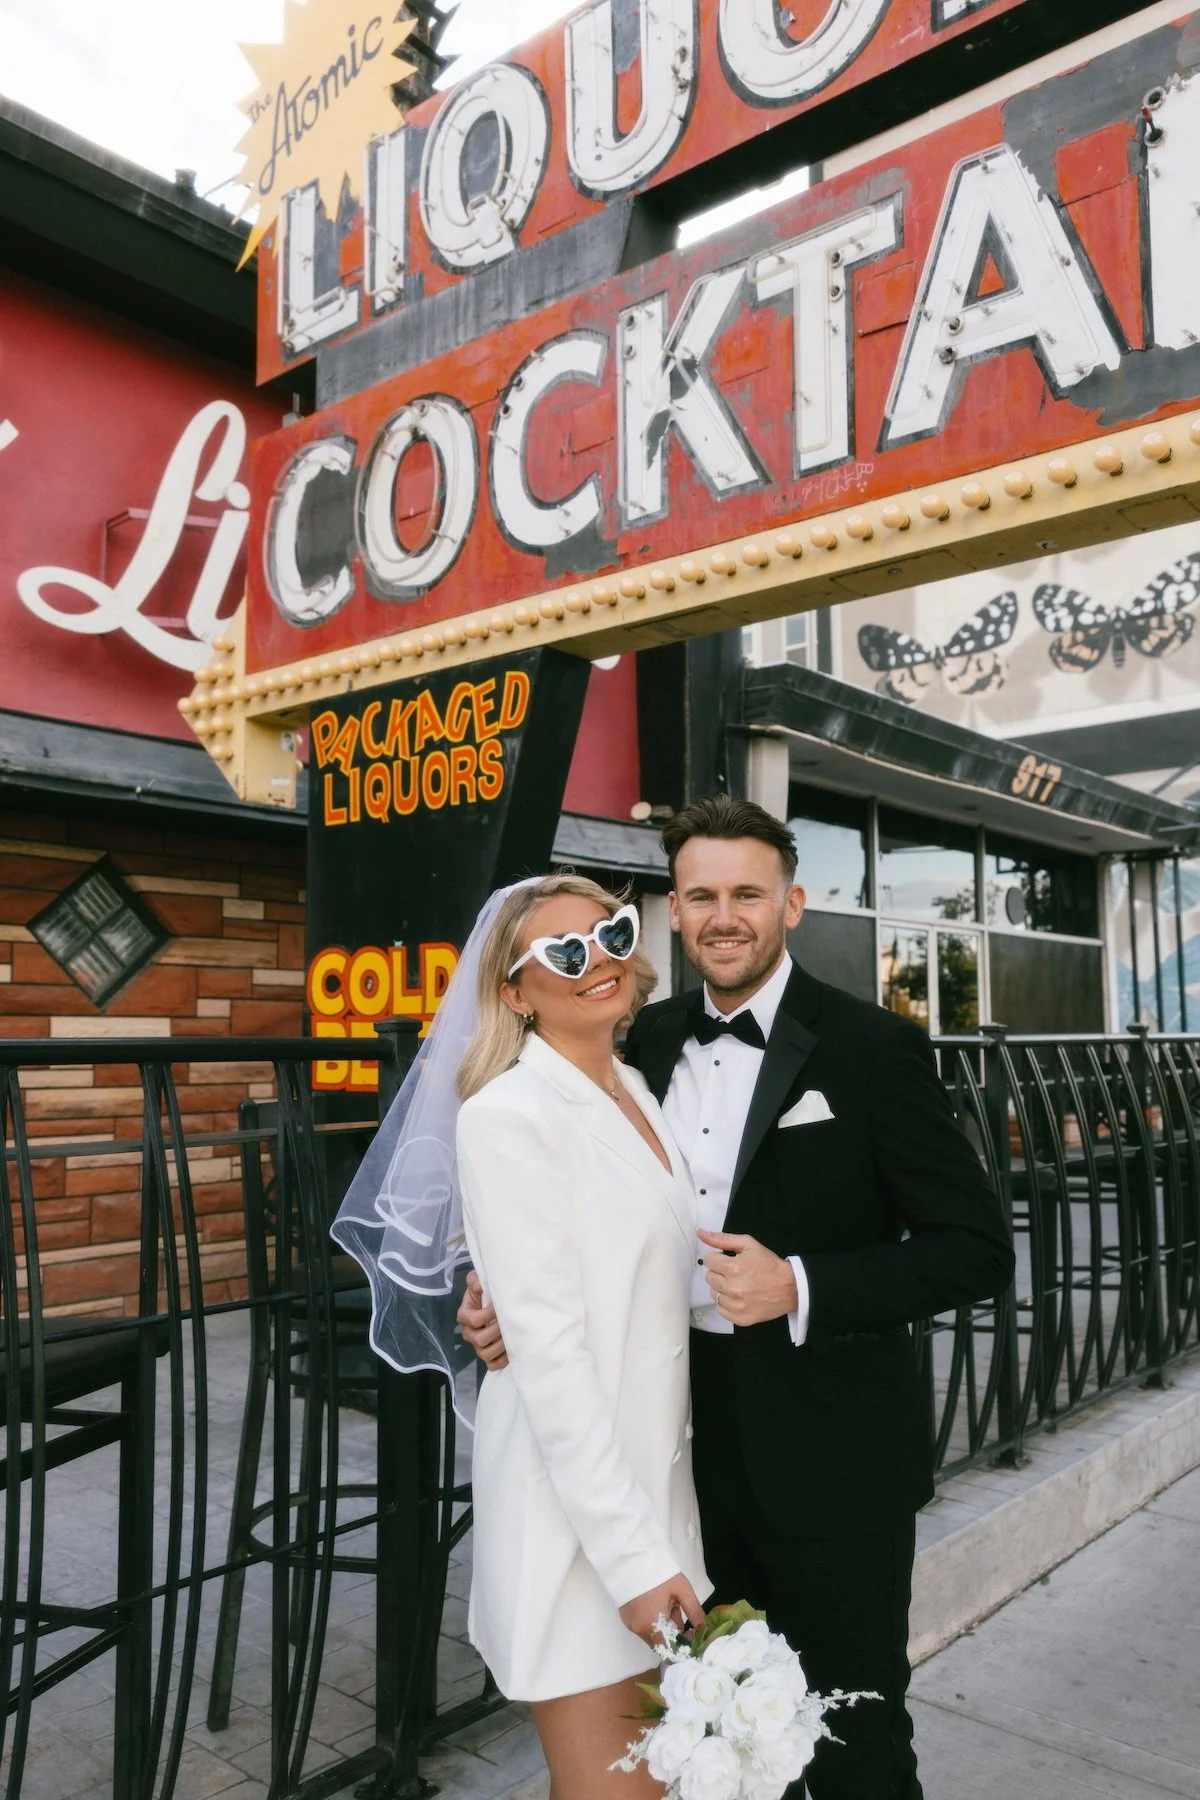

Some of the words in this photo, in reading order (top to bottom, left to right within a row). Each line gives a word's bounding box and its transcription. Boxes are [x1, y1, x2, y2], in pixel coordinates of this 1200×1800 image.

[259, 16, 384, 196] Atomic
[278, 0, 978, 354] LIQU
[311, 671, 530, 776] PACKAGED
[324, 738, 504, 826] LIQUORS
[1012, 754, 1062, 802] 917
[306, 942, 461, 1018] COLD
